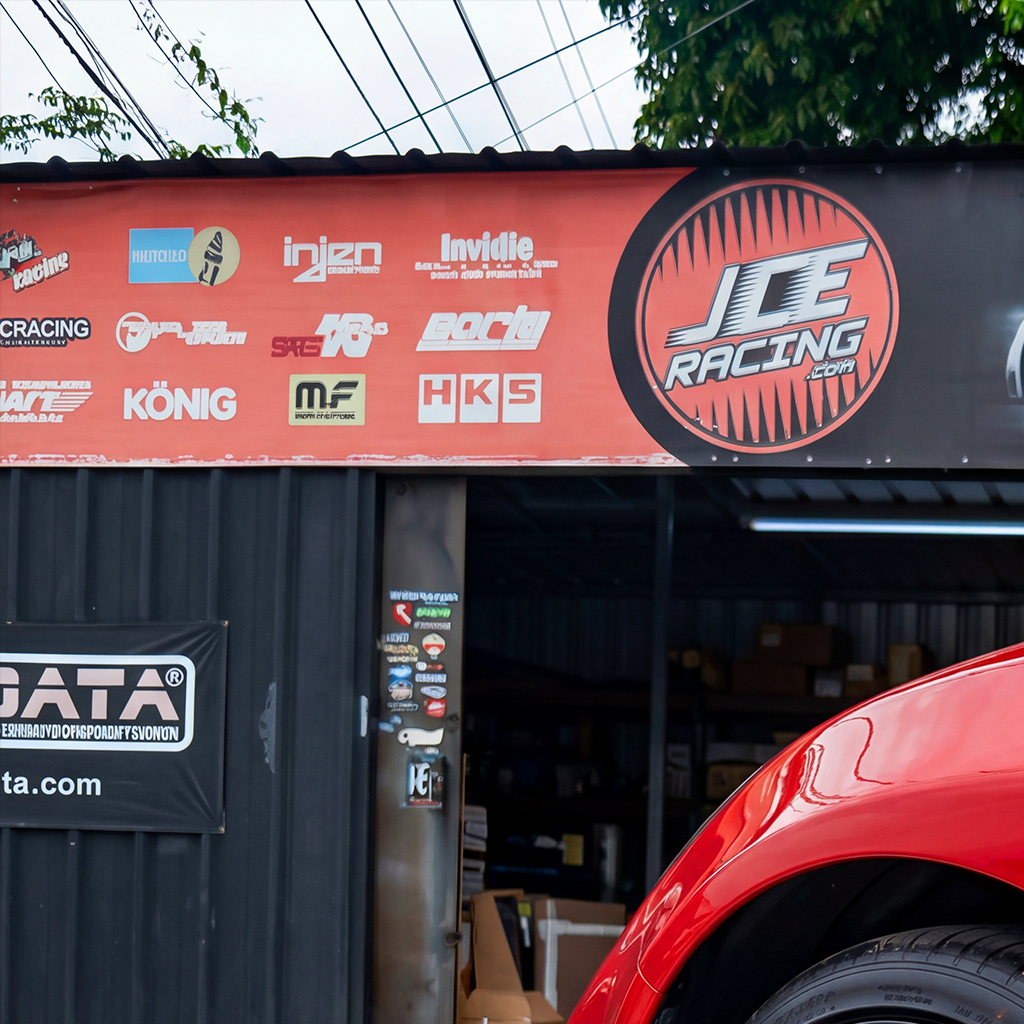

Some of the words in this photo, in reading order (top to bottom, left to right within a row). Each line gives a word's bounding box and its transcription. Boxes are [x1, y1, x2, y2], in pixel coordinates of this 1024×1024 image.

[664, 238, 869, 348] JCE
[664, 315, 869, 390] RACING
[123, 381, 237, 421] KÖNIG
[422, 378, 538, 406] HKS
